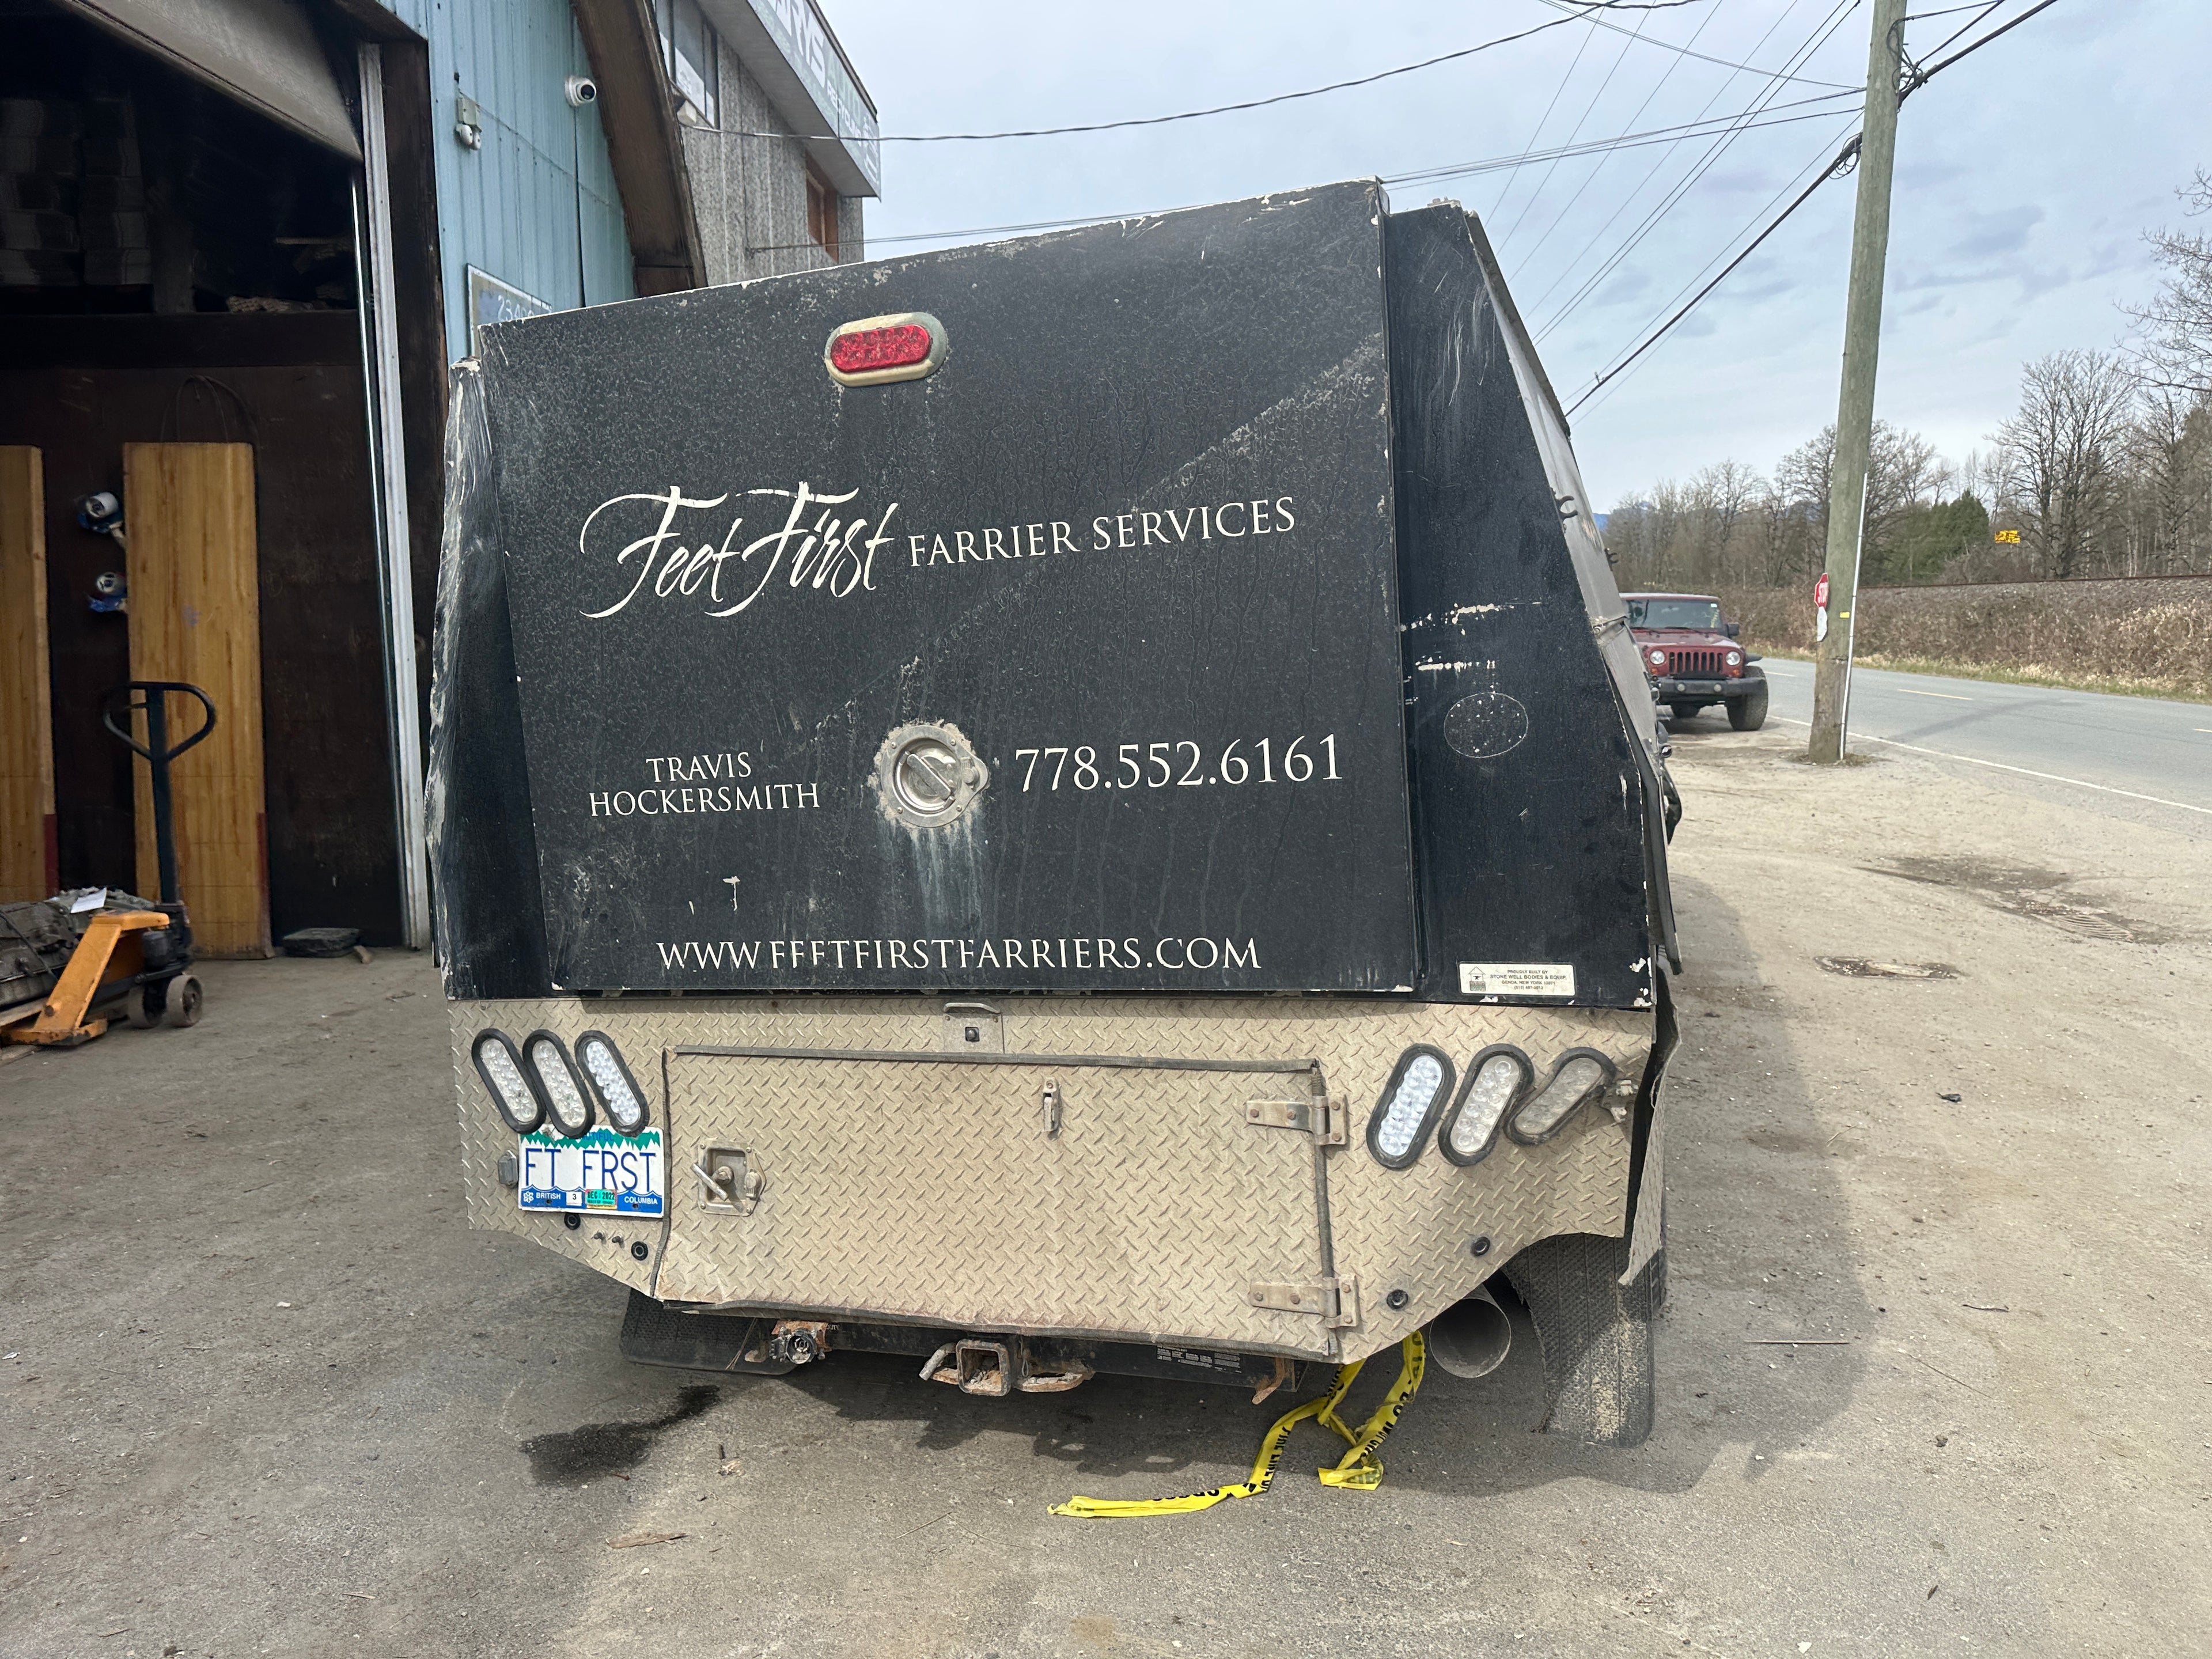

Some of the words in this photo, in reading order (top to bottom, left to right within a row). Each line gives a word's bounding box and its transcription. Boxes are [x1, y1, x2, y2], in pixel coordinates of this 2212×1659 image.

[579, 485, 740, 619] Feet
[704, 480, 899, 618] First
[907, 521, 1081, 567] FARRIER
[1092, 496, 1296, 551] SERVICES
[646, 752, 752, 783] TRAVIS
[1015, 733, 1343, 792] 778.552.6161
[589, 783, 820, 816] HOCKERSMITH
[525, 1147, 562, 1187] FT
[582, 1149, 656, 1192] FRST
[536, 1191, 562, 1199] BRITISH
[624, 1195, 658, 1205] COLUMBIA
[587, 1191, 598, 1199] DEC
